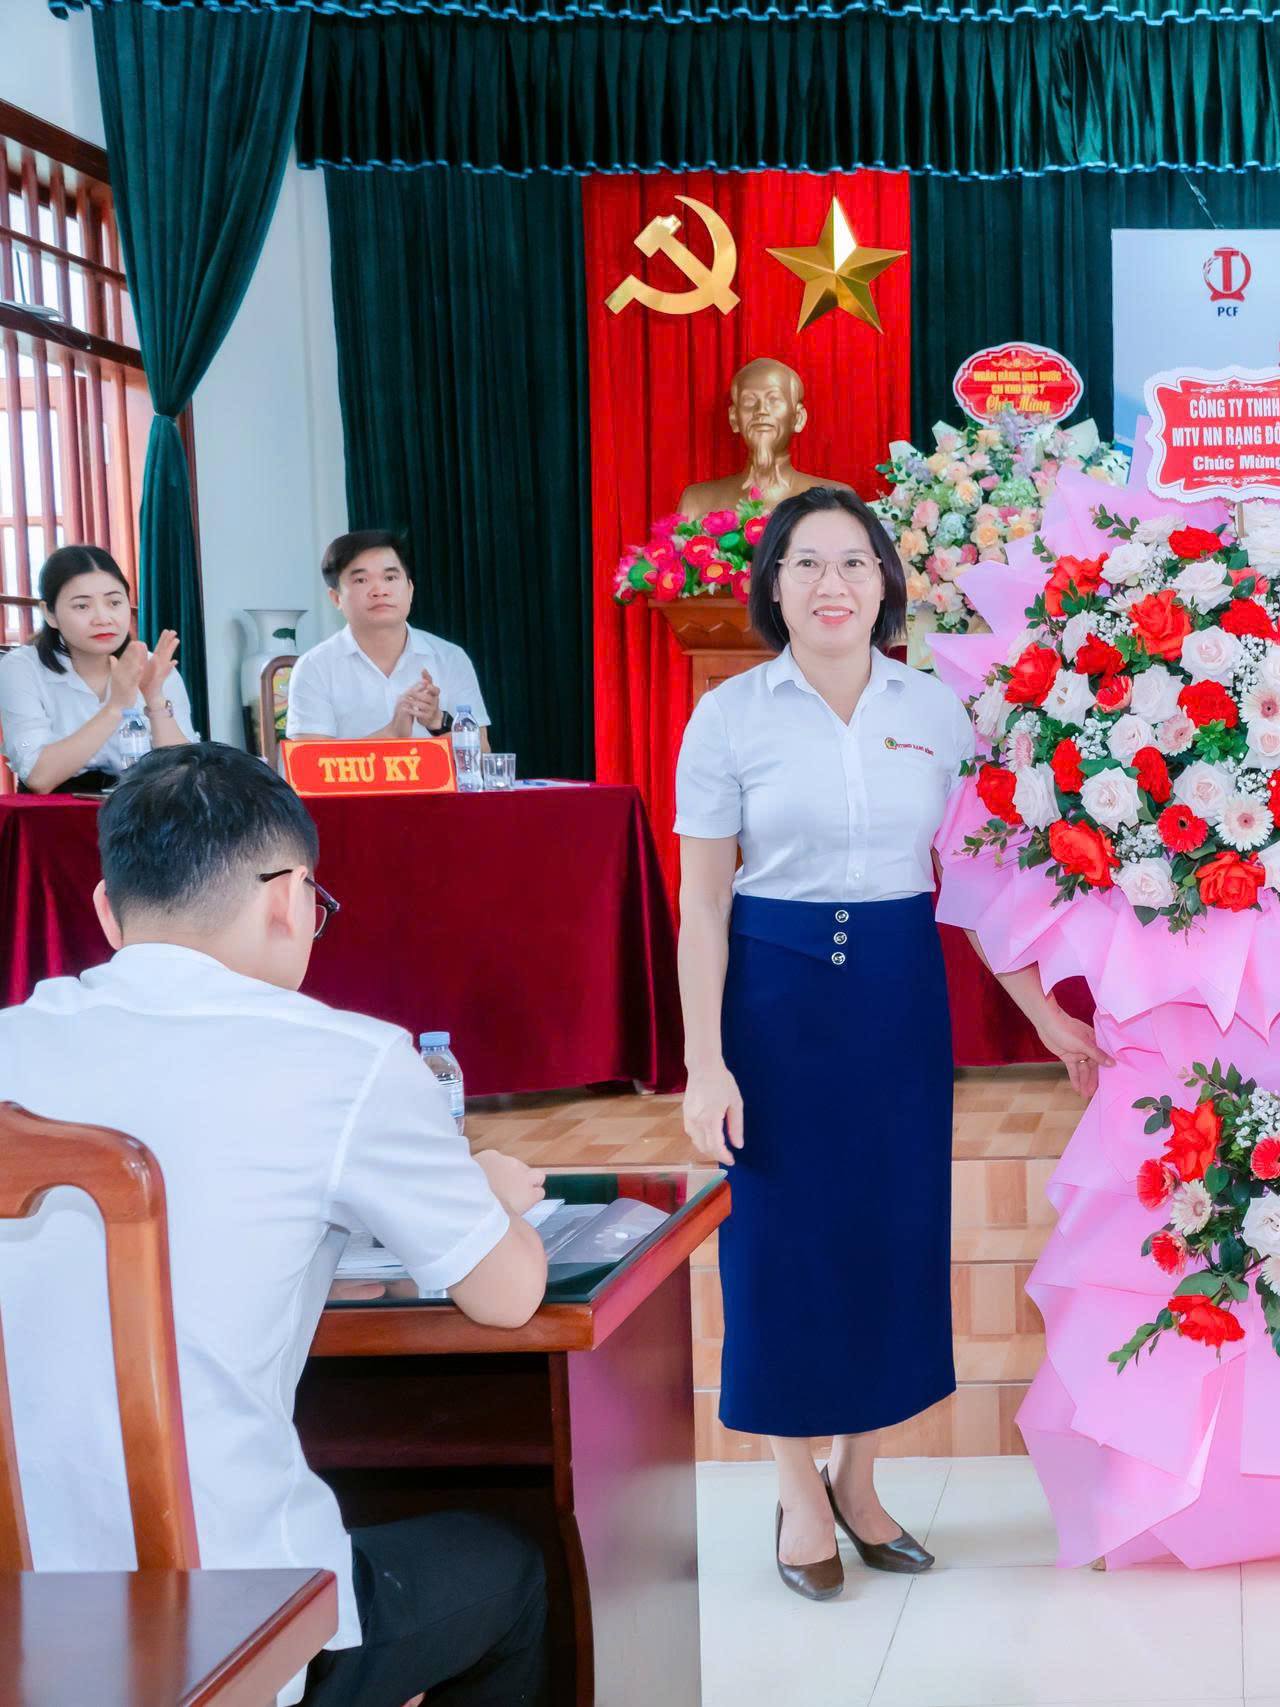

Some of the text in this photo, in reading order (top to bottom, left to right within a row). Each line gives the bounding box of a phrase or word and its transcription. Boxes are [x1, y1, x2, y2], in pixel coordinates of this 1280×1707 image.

[1217, 306, 1239, 317] PCF
[1190, 396, 1280, 418] CÔNG TY TNHH
[1172, 427, 1200, 447] MTV
[1203, 427, 1223, 446] NN
[1226, 425, 1263, 450] RẠNG
[1193, 454, 1235, 470] Chúc
[318, 747, 422, 783] THƯ KÝ
